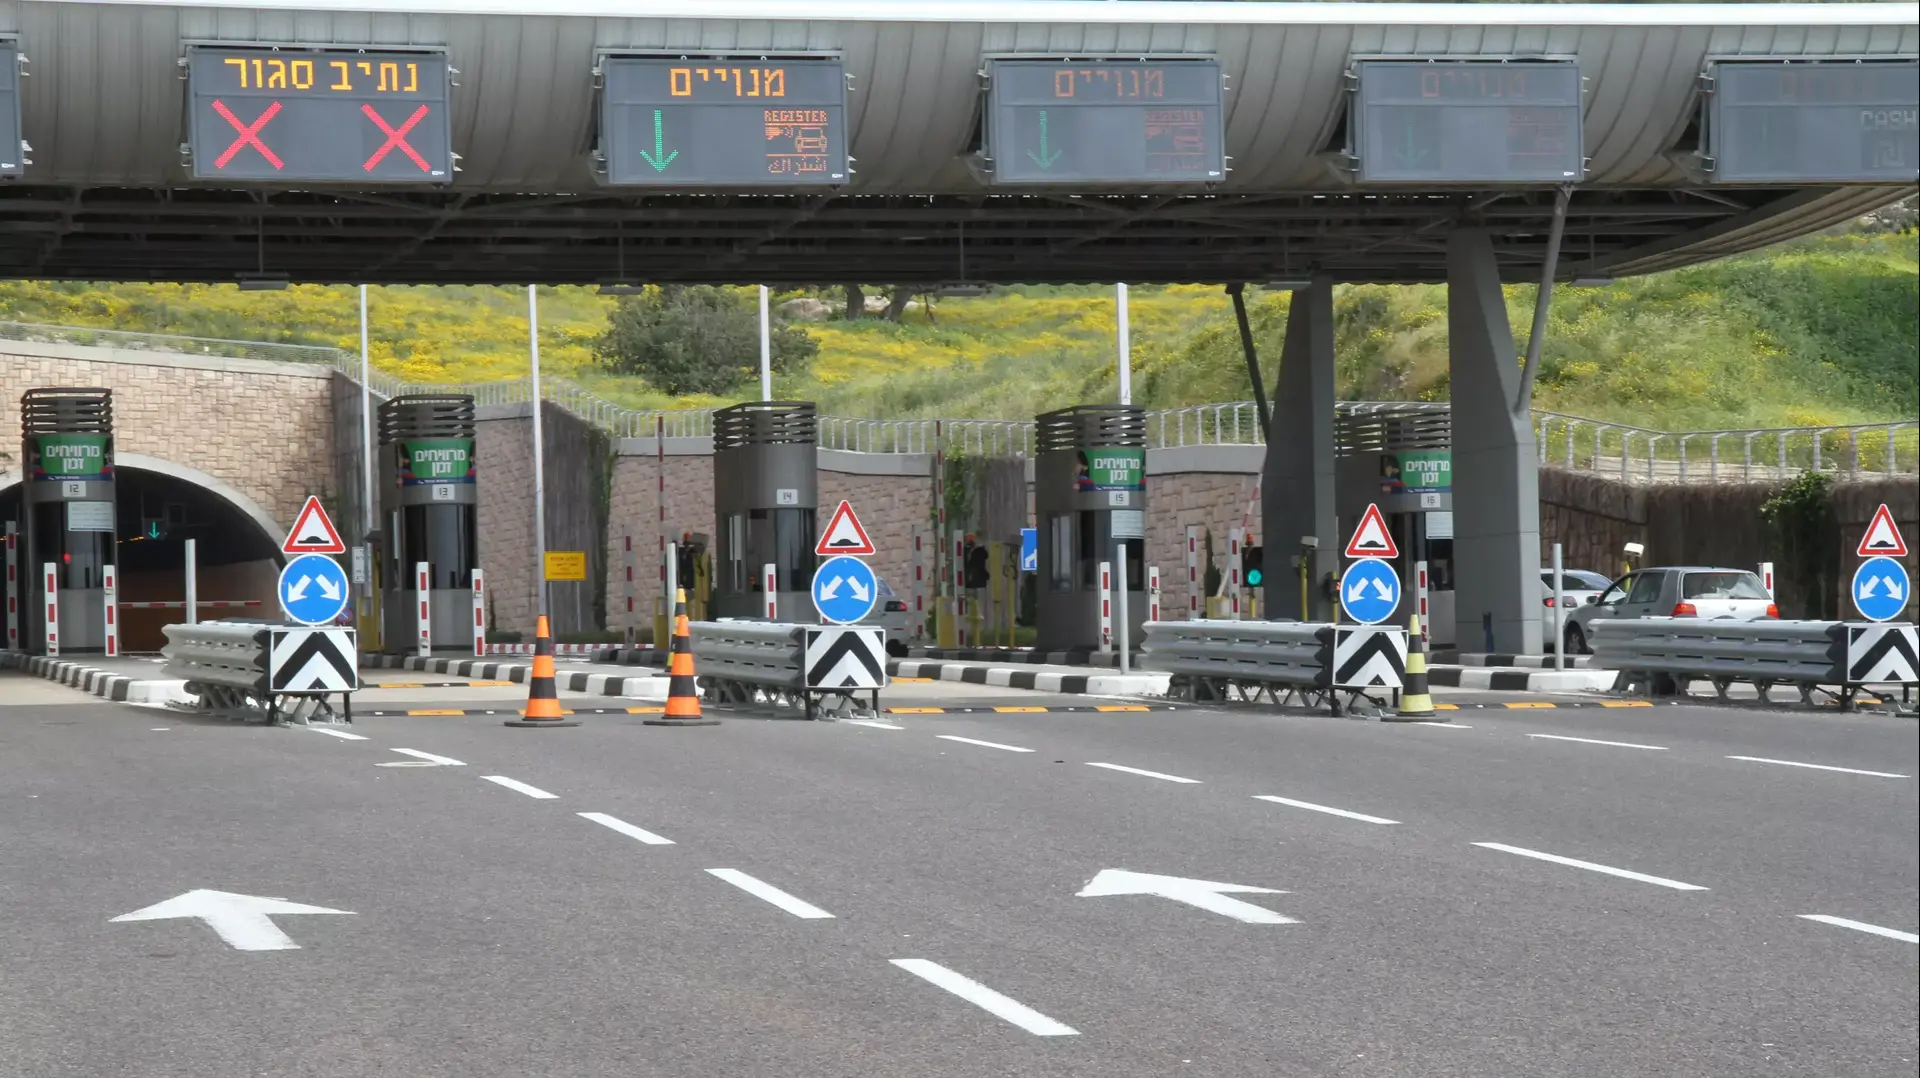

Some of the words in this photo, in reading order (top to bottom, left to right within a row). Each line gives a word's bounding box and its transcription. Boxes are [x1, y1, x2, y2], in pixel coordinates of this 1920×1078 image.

[224, 57, 313, 90] סגור
[330, 61, 418, 92] נתיב
[670, 67, 785, 97] מנויים
[1054, 69, 1164, 98] מנויים
[764, 110, 828, 122] REGISTER
[63, 458, 84, 473] זמן
[431, 462, 452, 477] זמן
[1110, 470, 1128, 484] זמן
[1421, 472, 1440, 486] זמן
[69, 484, 80, 493] 12
[438, 487, 449, 496] 13
